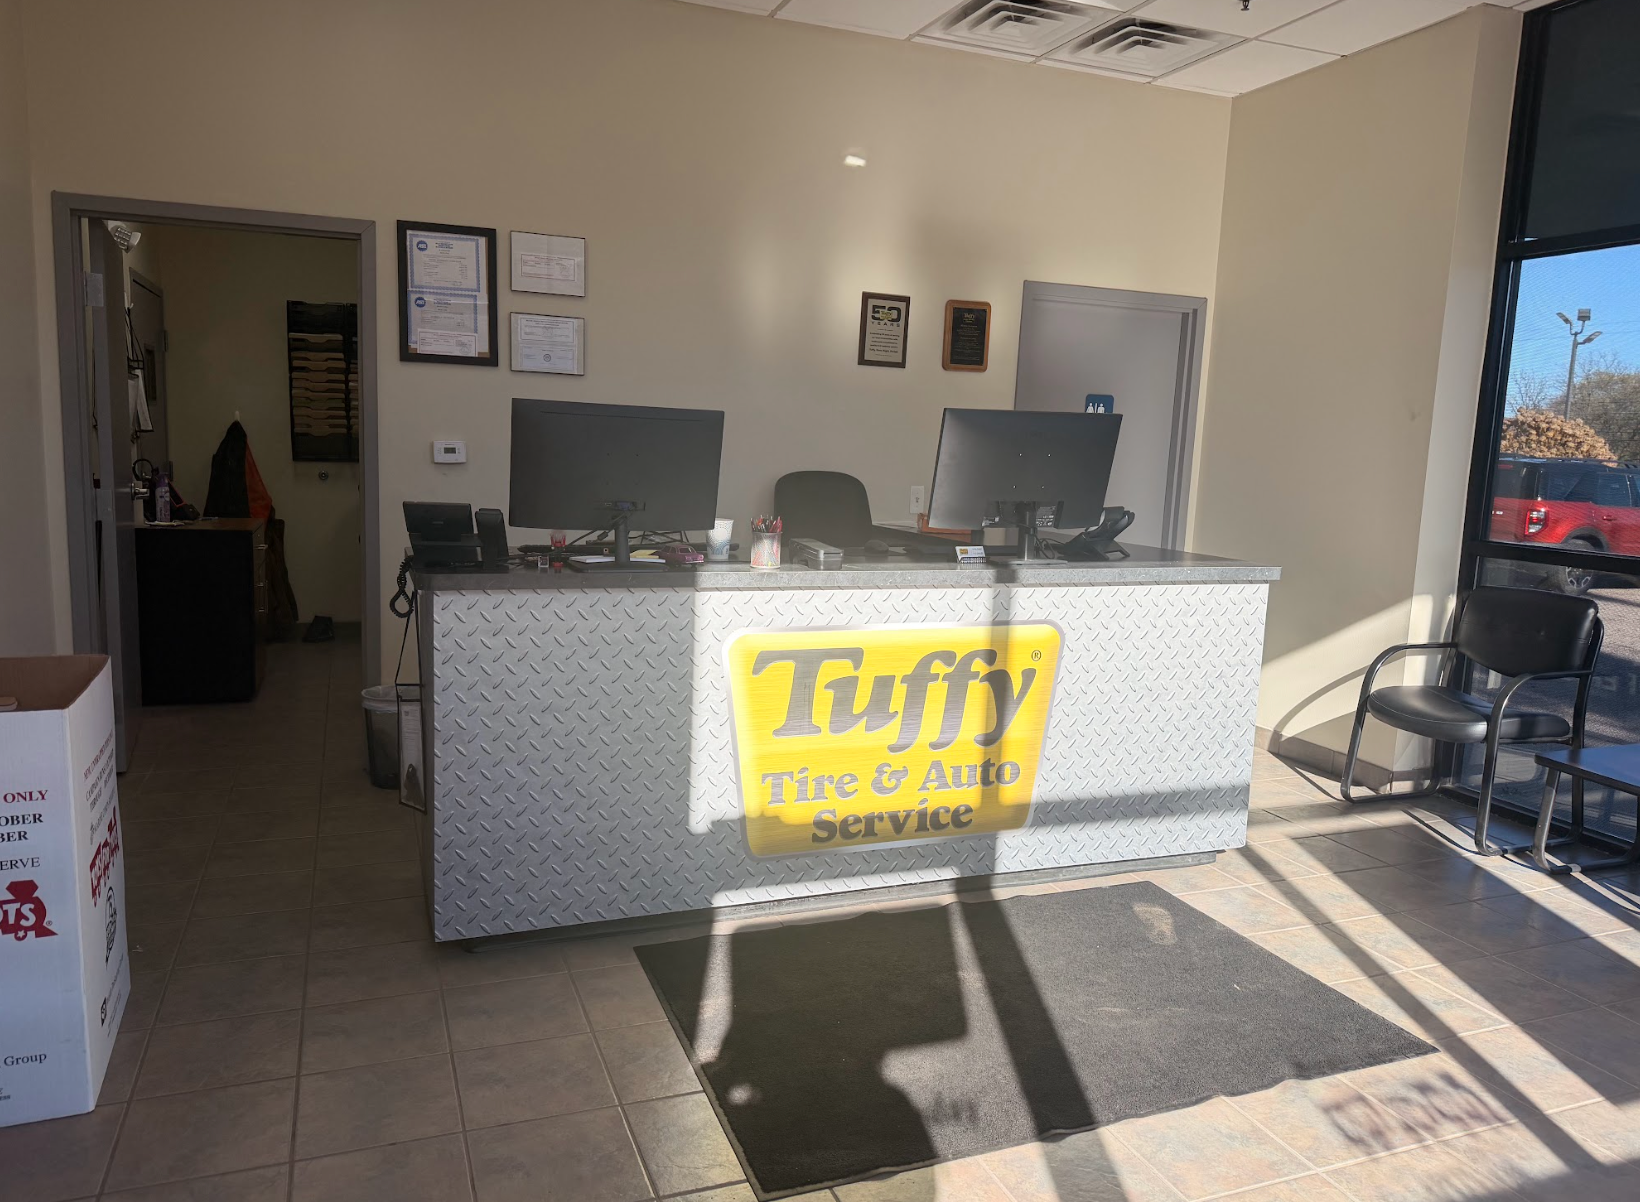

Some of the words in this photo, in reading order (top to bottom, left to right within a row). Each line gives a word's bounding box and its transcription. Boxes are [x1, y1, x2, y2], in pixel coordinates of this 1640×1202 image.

[871, 304, 901, 322] 50
[752, 646, 1037, 754] Tuffy
[761, 766, 859, 805] Tire
[870, 763, 908, 796] &
[917, 757, 1021, 794] Auto
[3, 789, 48, 804] ONLY
[811, 797, 974, 844] Service
[0, 902, 36, 927] TS
[3, 1053, 47, 1067] Group
